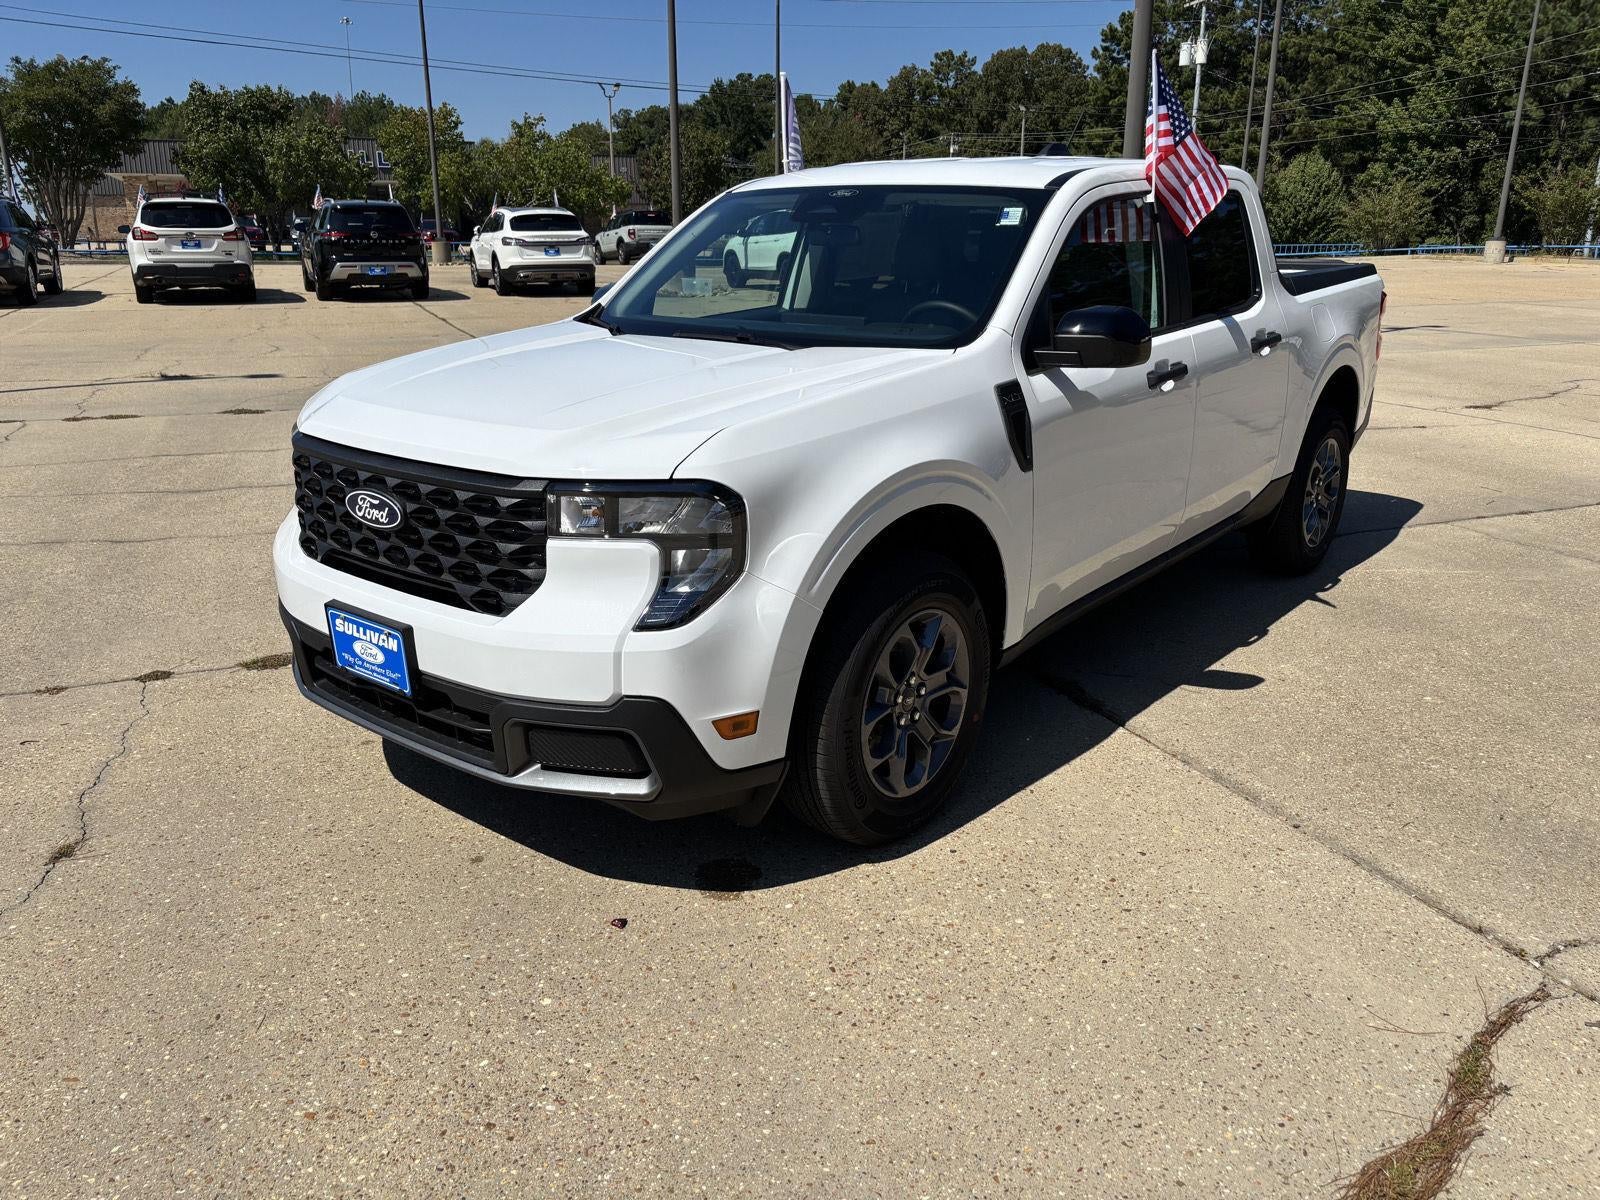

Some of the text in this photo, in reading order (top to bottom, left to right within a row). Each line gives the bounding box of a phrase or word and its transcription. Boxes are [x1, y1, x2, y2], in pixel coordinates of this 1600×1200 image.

[356, 495, 389, 523] Ford
[335, 618, 398, 652] SULLIVAN
[359, 644, 378, 661] Ford
